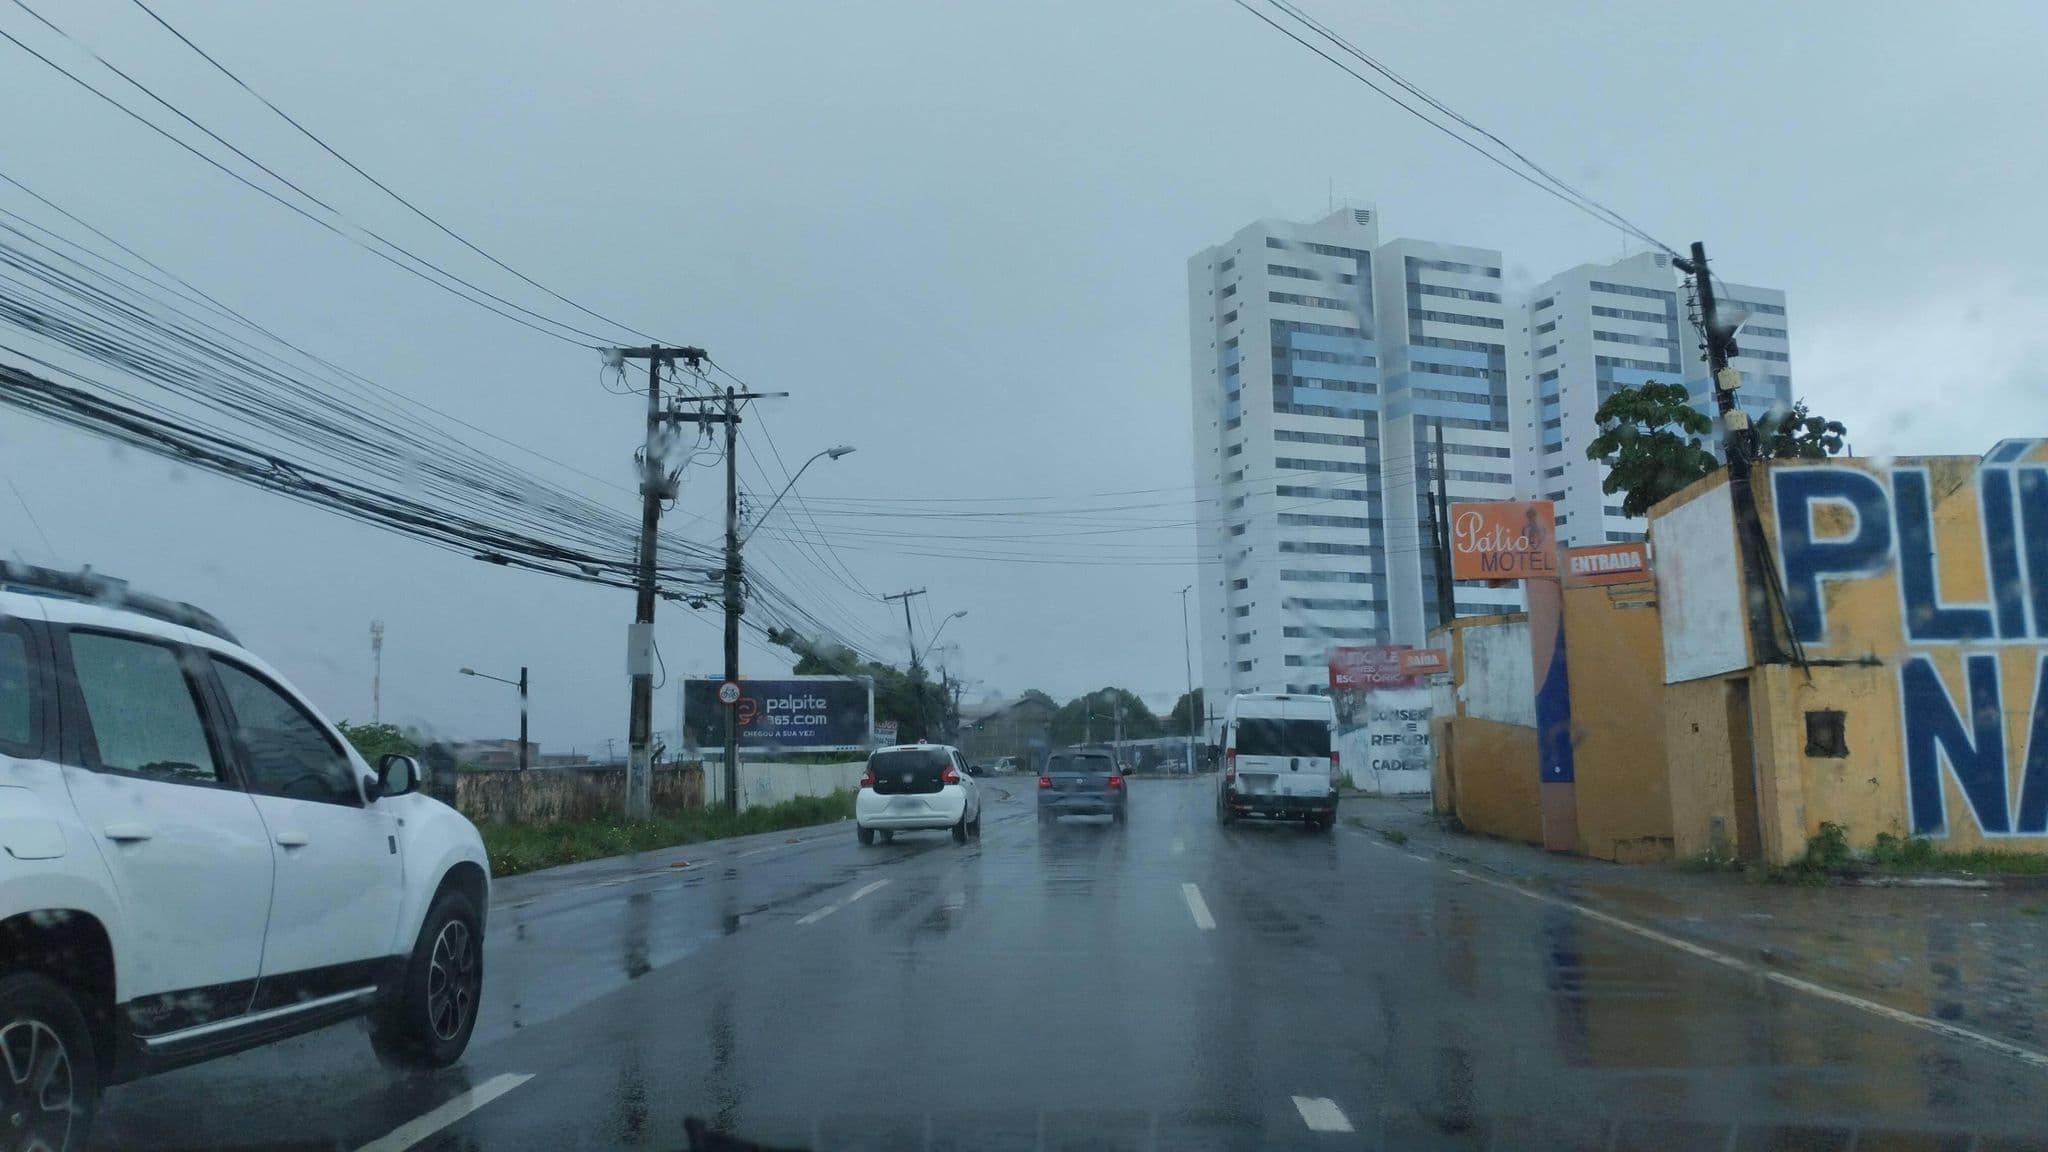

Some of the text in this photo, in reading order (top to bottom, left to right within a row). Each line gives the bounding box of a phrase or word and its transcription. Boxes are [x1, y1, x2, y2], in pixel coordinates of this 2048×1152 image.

[1456, 511, 1530, 553] Pátio
[1481, 551, 1554, 572] MOTEL
[1571, 551, 1642, 575] ENTRADA
[766, 694, 827, 713] palpite
[1899, 652, 2048, 840] N
